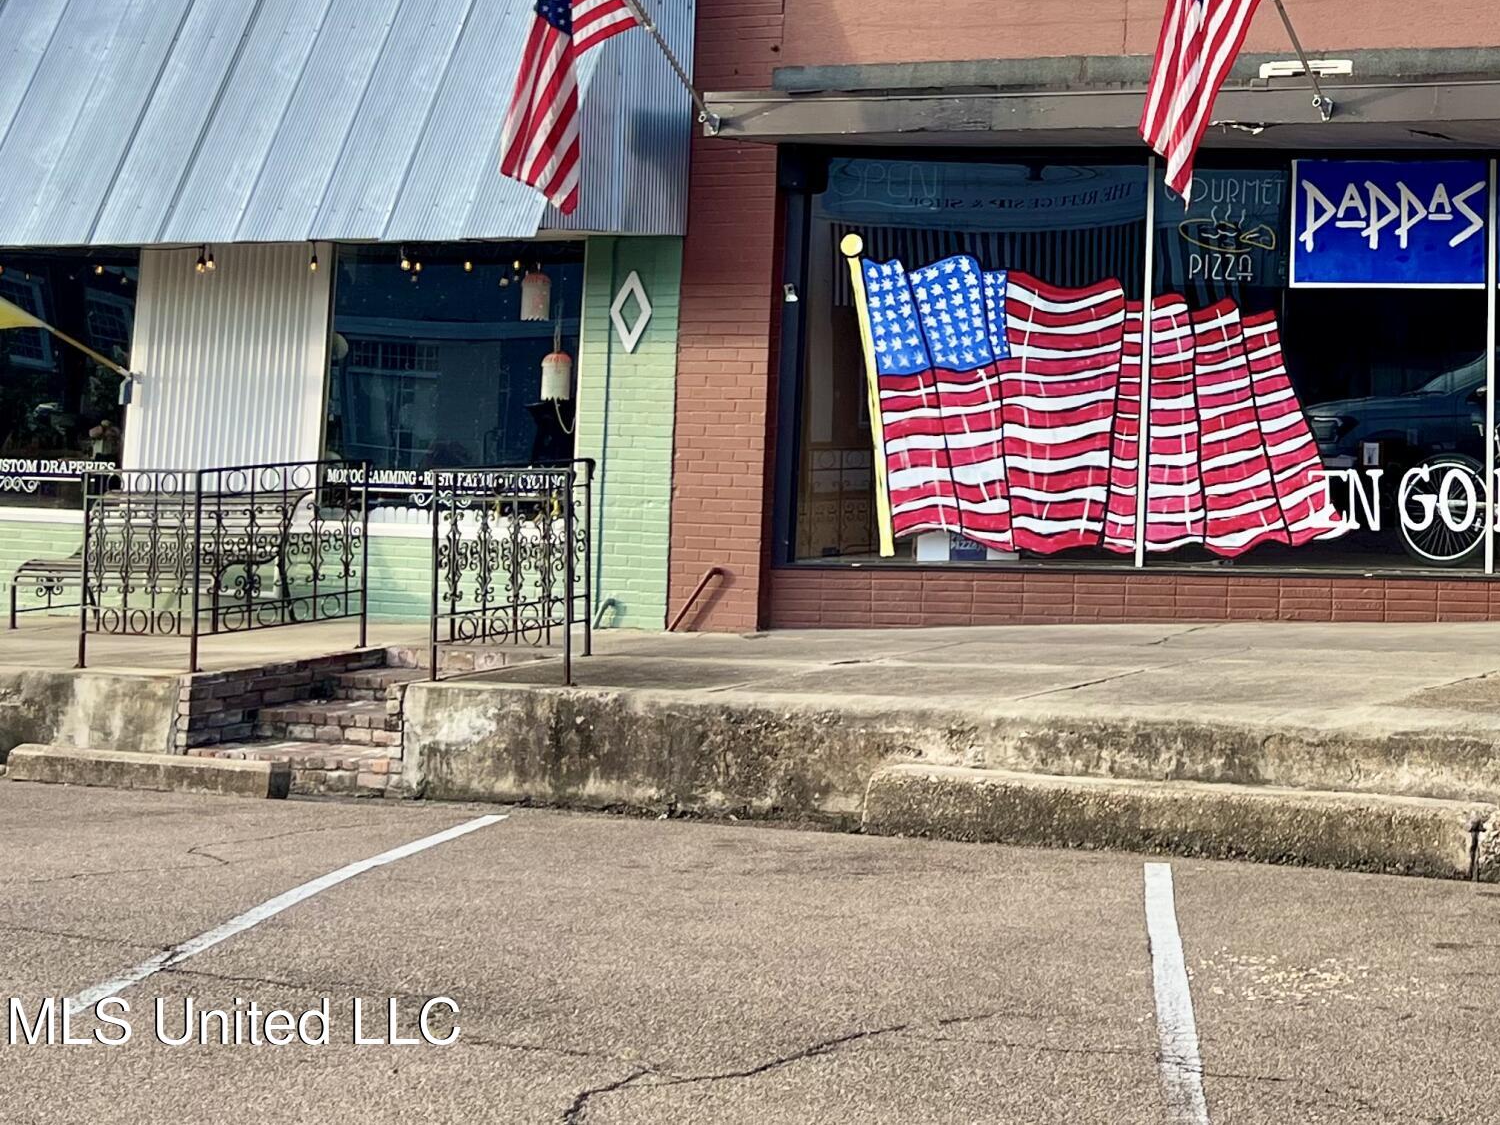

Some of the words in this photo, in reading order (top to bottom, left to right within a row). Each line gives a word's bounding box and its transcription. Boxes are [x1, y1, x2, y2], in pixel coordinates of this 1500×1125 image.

[831, 163, 938, 198] OPEN
[1299, 179, 1487, 252] PAPPAS
[1188, 253, 1253, 282] PIZZA
